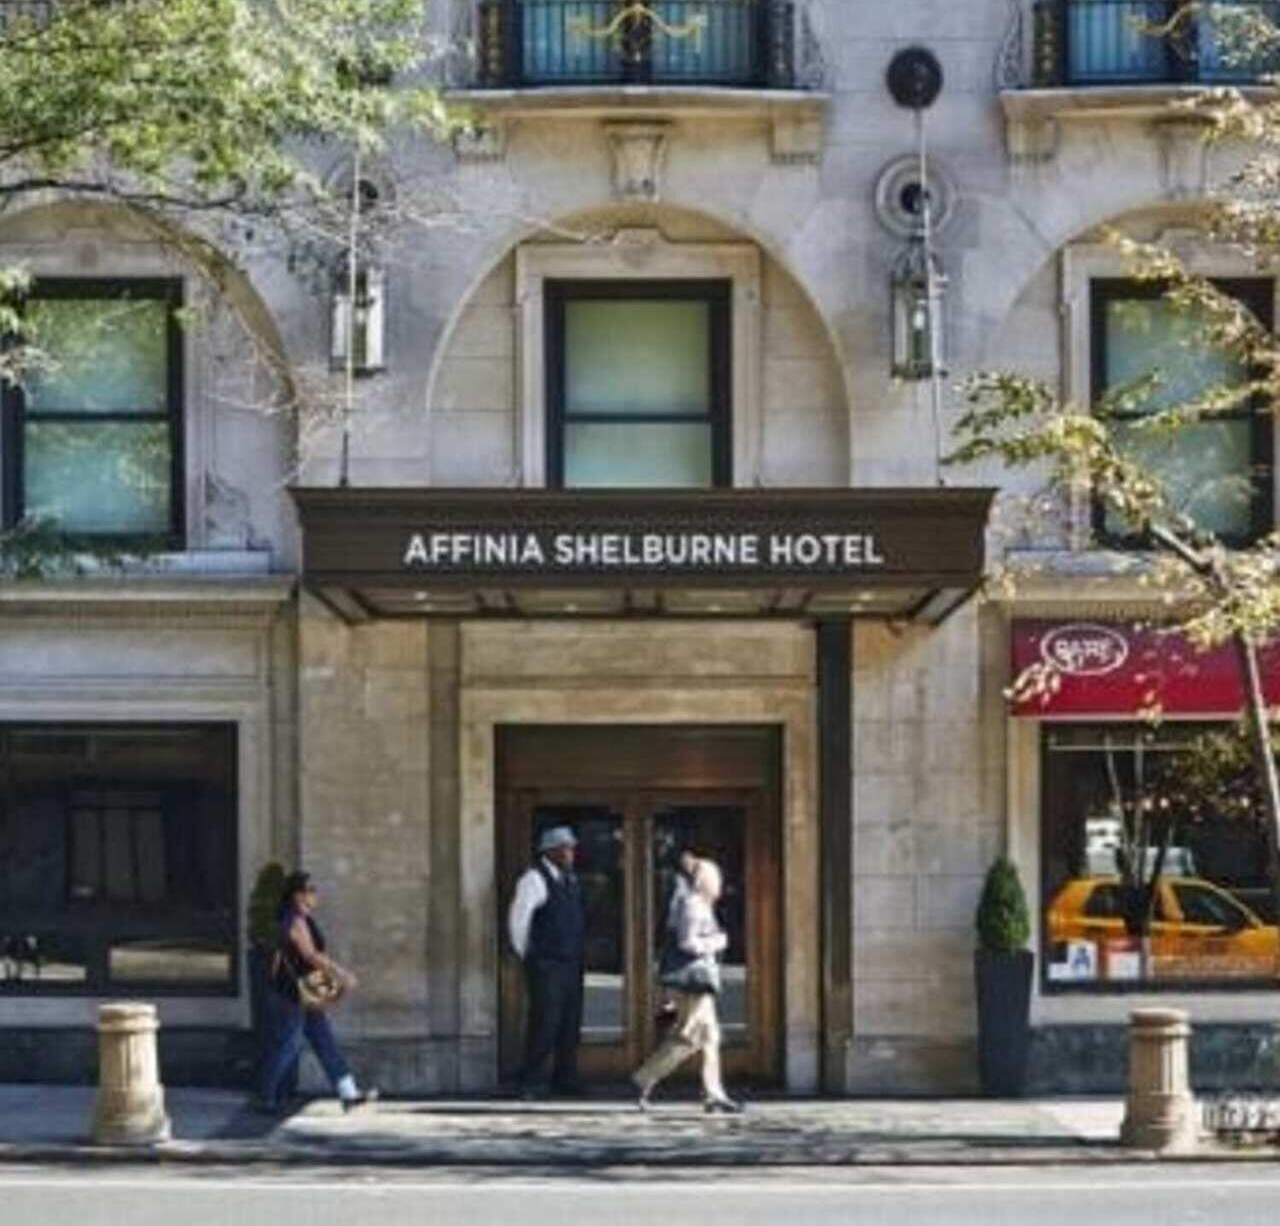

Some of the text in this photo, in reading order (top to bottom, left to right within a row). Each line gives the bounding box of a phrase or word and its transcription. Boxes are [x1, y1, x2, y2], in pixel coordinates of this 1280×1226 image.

[402, 533, 883, 565] AFFINIA SHELBURNE HOTEL
